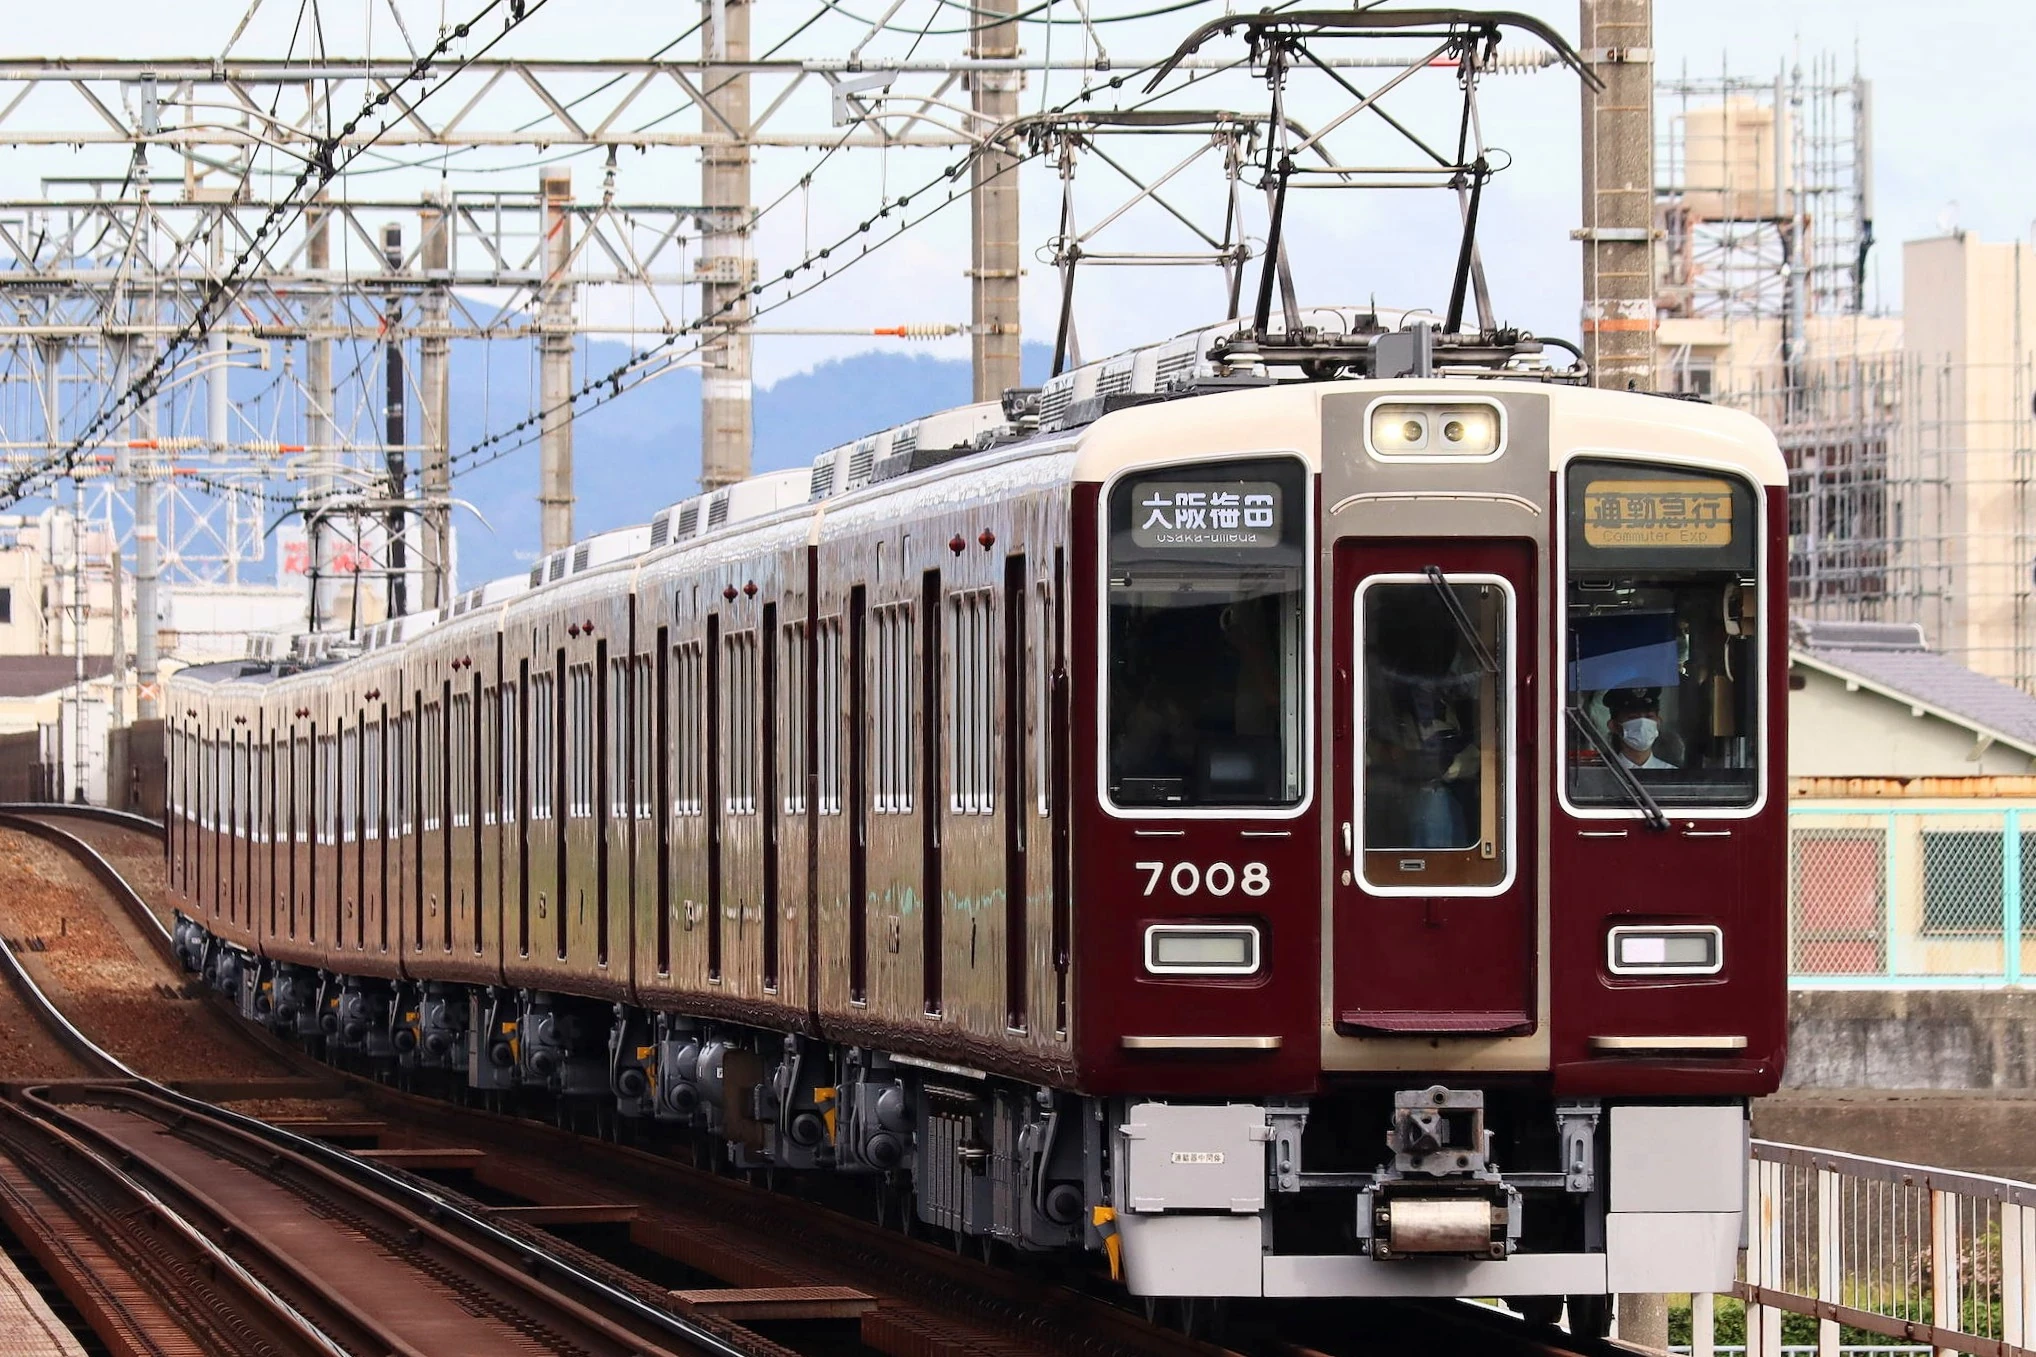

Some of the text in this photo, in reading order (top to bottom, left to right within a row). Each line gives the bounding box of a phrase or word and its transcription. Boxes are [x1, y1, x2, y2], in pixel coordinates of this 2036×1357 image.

[1141, 491, 1274, 530] 大阪梅田
[1593, 492, 1721, 529] 通勤急行
[1602, 529, 1708, 543] Commuter Exp
[1135, 861, 1271, 897] 7008
